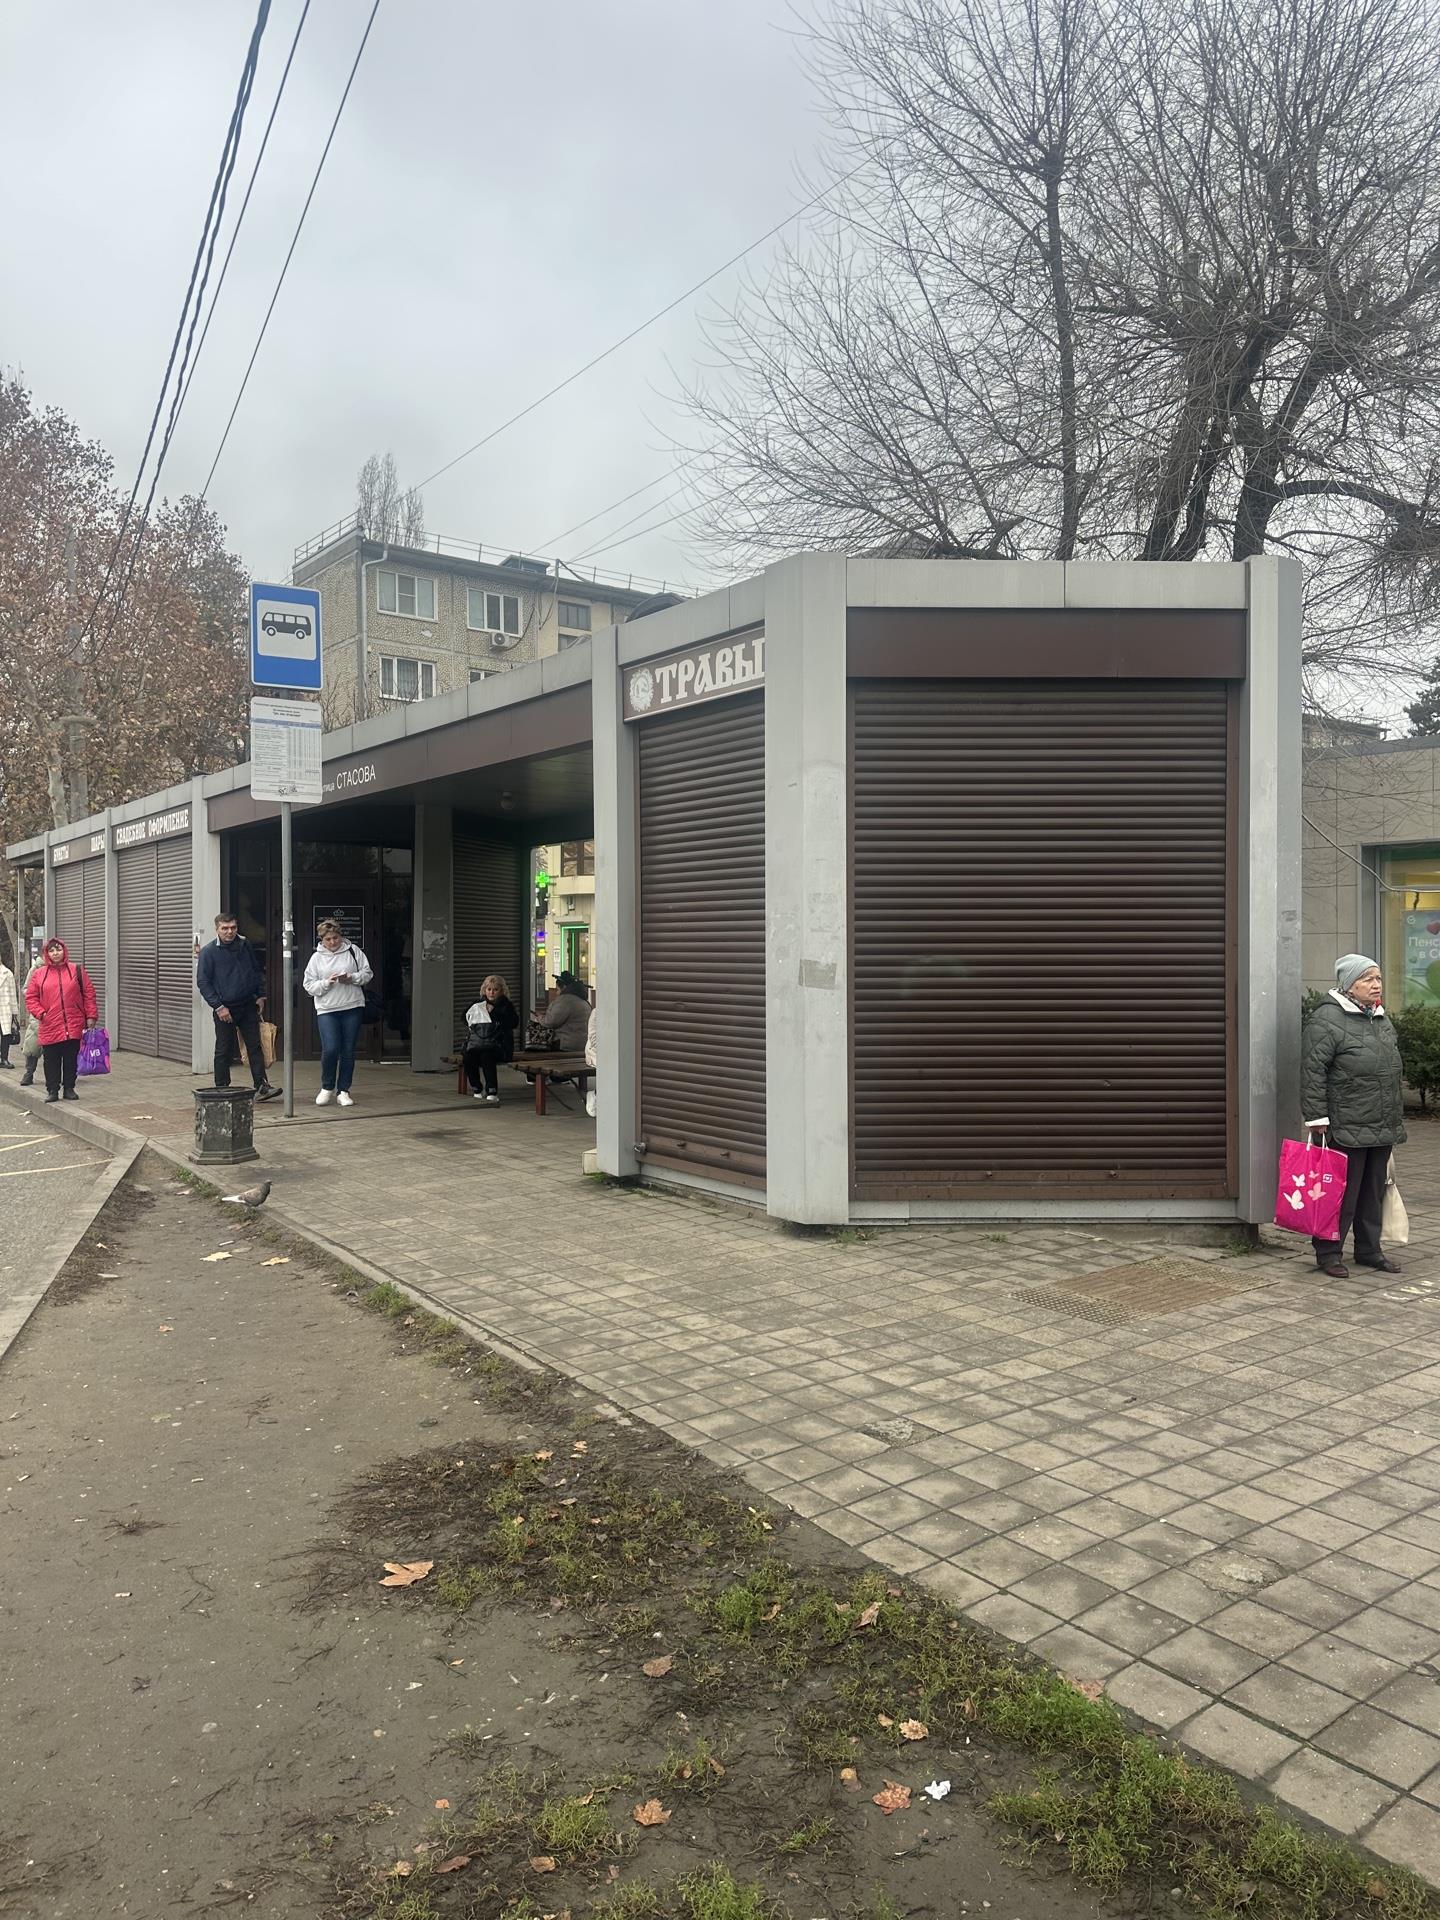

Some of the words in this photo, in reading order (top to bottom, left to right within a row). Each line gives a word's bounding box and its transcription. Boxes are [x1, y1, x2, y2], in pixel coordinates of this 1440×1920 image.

[655, 638, 765, 703] ТРАВЫ
[322, 782, 335, 792] лица
[337, 764, 376, 789] СТАСОВА
[116, 821, 146, 845] СВАДЕБНОЕ
[148, 809, 189, 837] ОФОРМЛЕНИЕ
